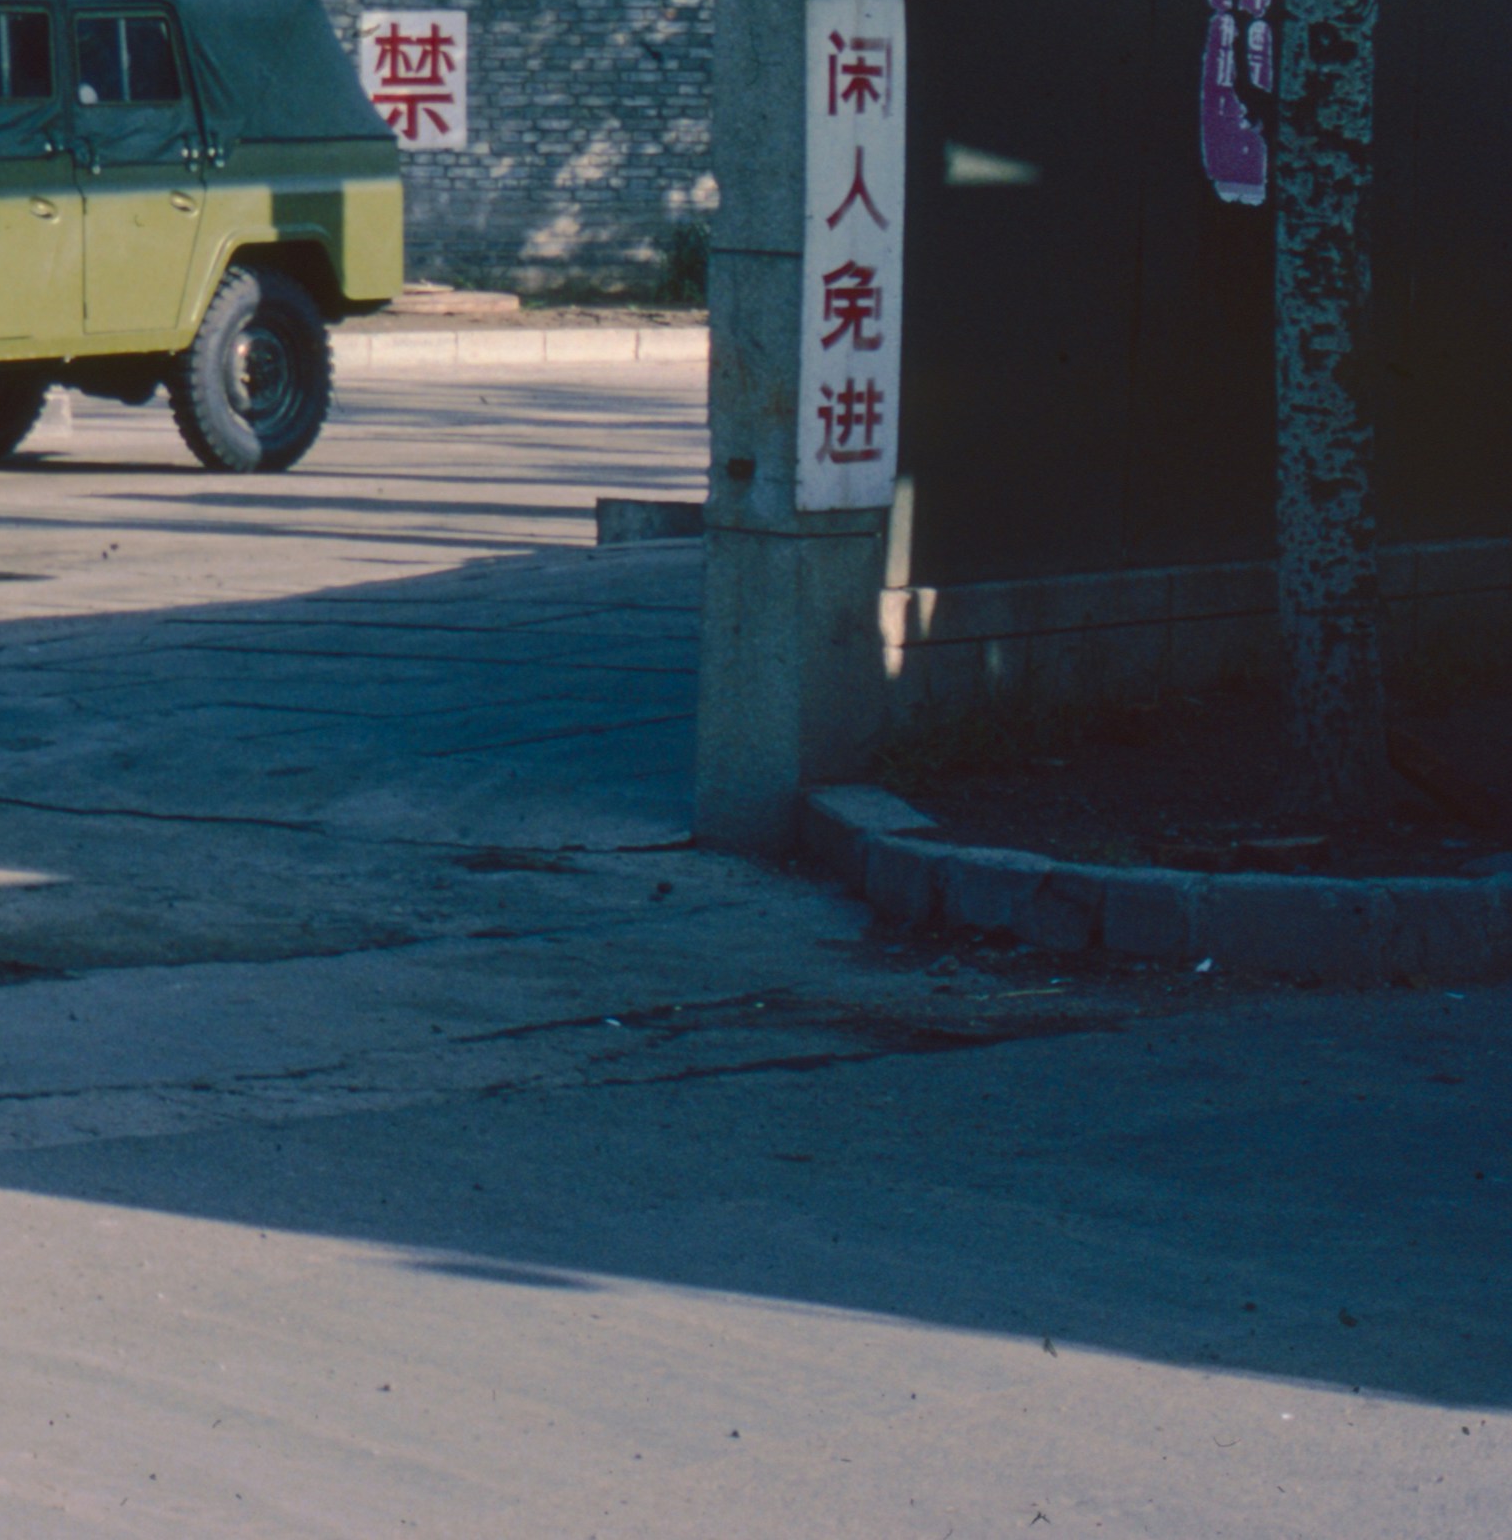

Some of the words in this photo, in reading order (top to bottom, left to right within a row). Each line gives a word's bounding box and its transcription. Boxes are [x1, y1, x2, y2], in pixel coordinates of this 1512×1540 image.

[372, 22, 456, 141] 禁
[815, 30, 893, 464] 闲人免进
